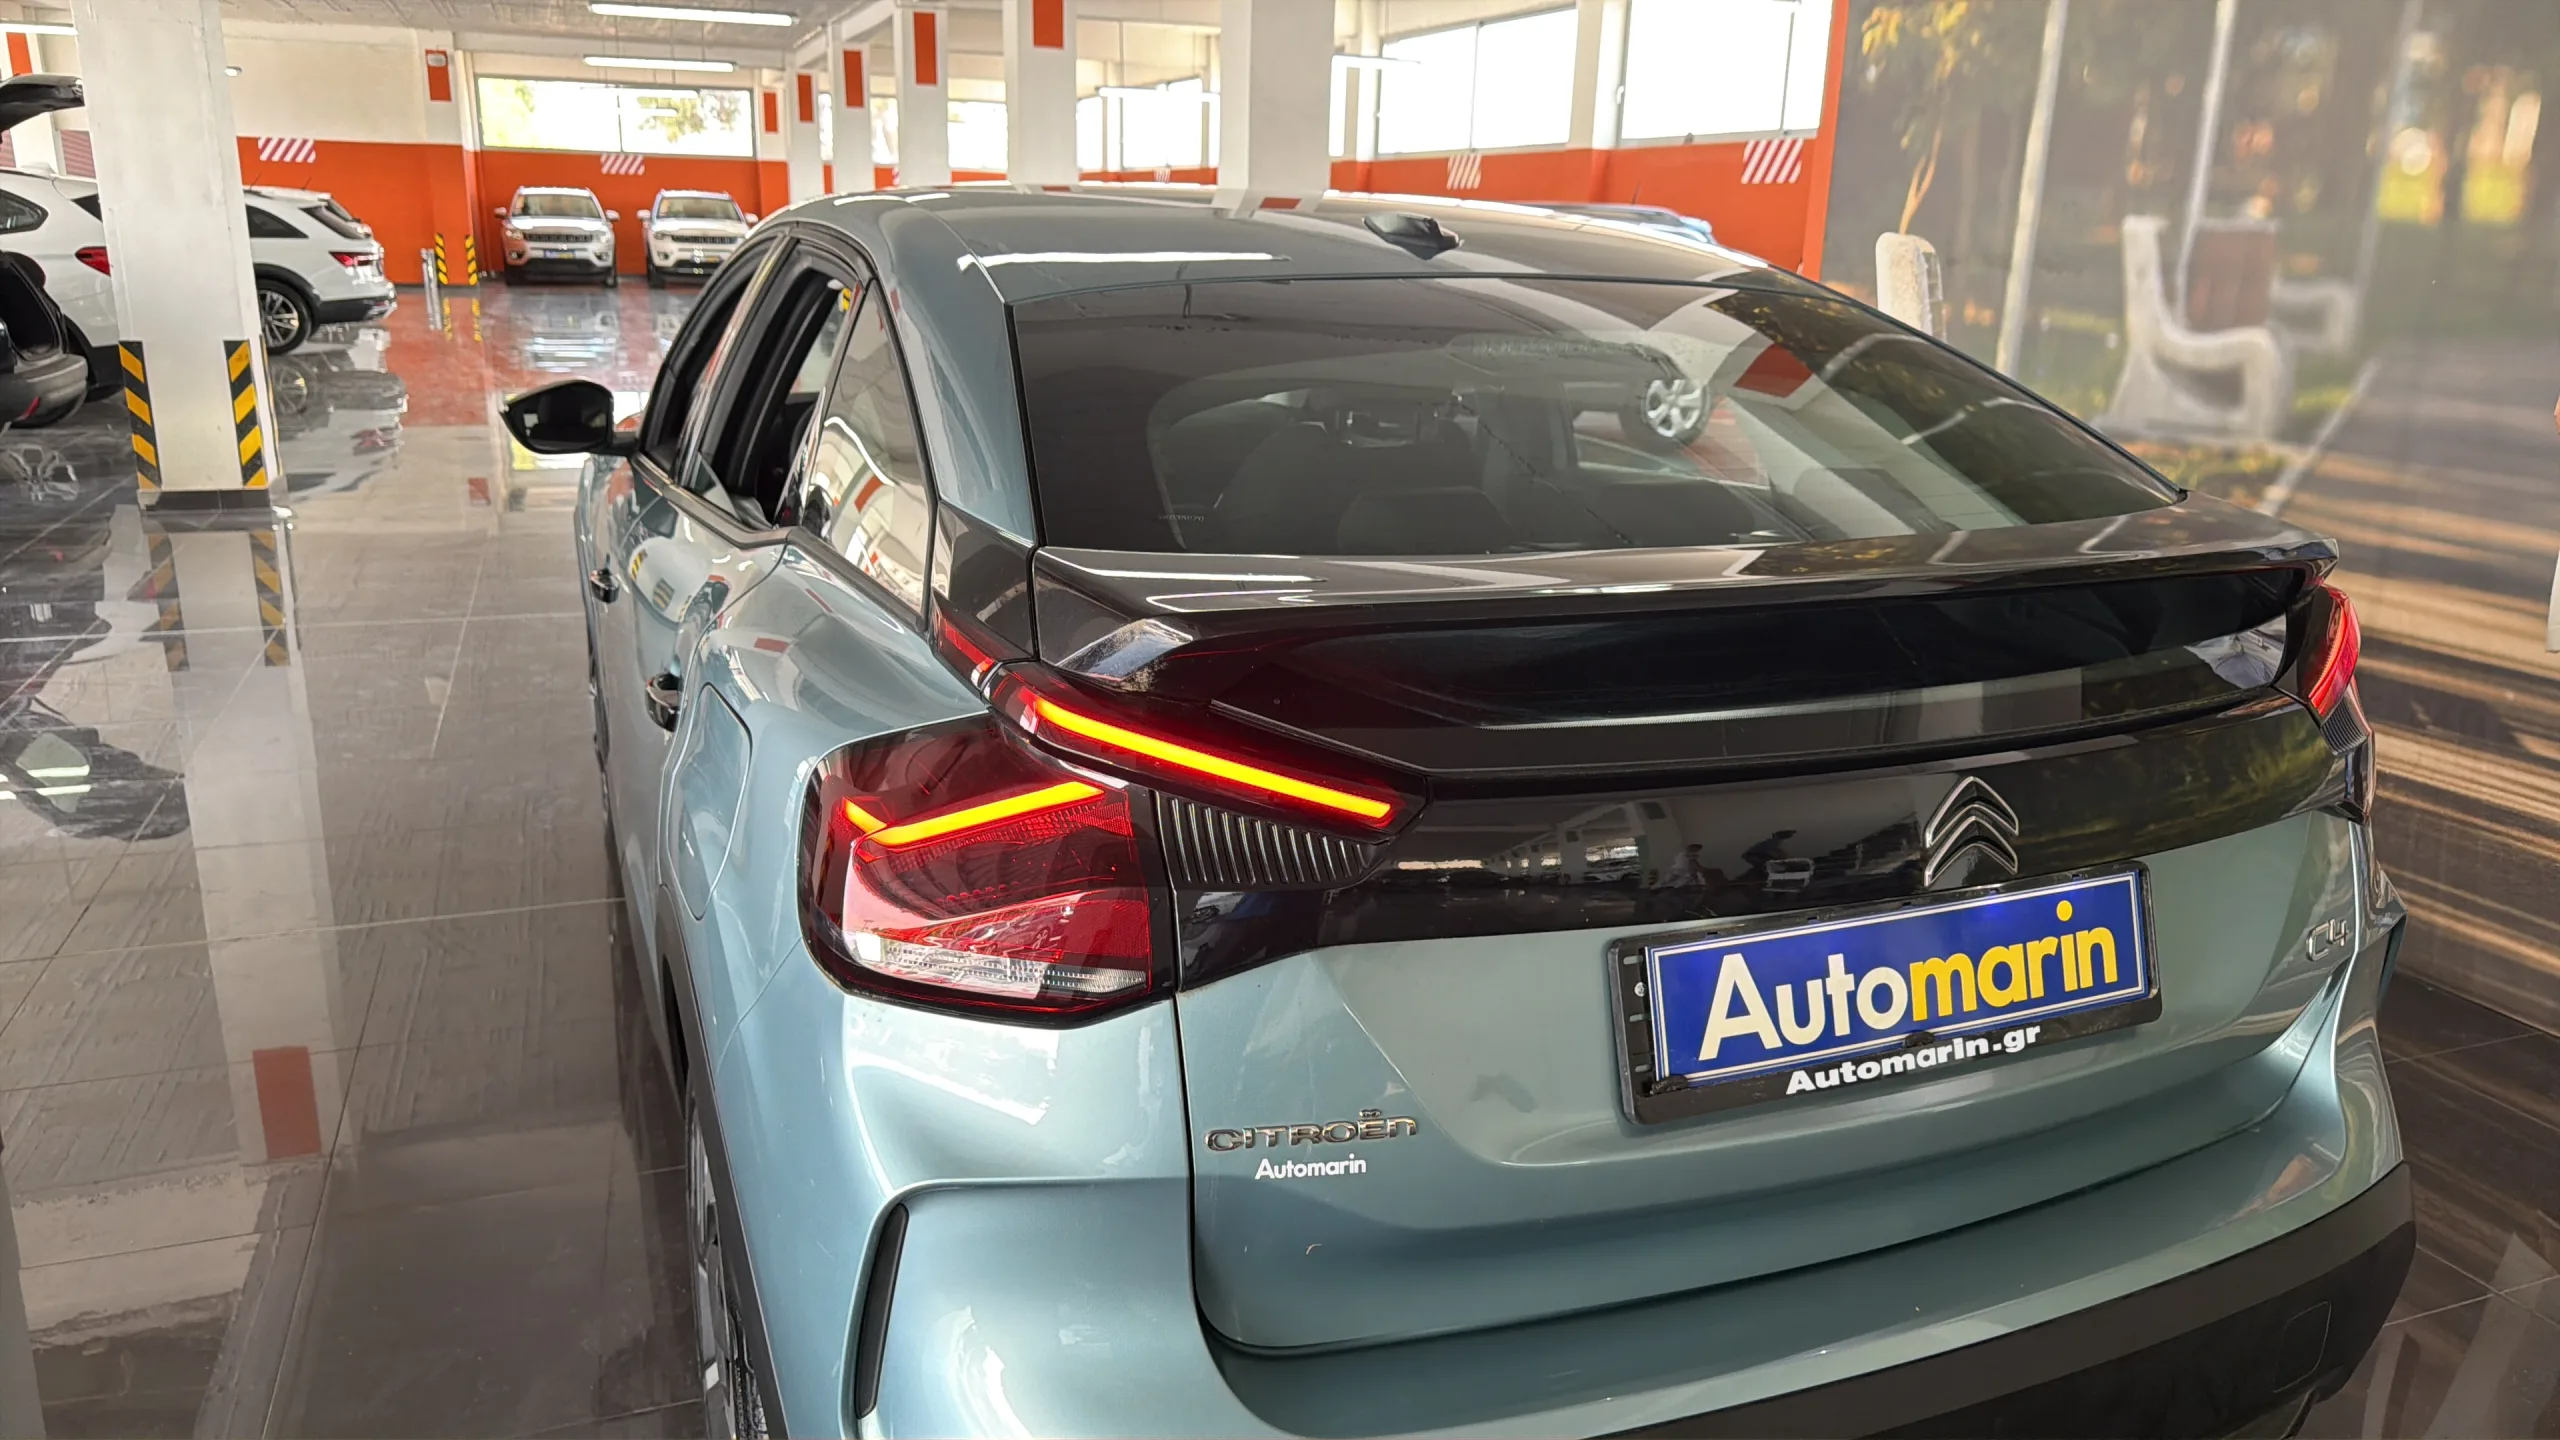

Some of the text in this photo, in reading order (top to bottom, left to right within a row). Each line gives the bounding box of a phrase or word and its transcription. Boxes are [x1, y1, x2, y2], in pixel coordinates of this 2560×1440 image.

[2306, 919, 2349, 961] C4
[1698, 900, 2118, 1061] Automarin
[1785, 1023, 2041, 1095] Automarin.gr
[1255, 1153, 1367, 1180] Automarin
